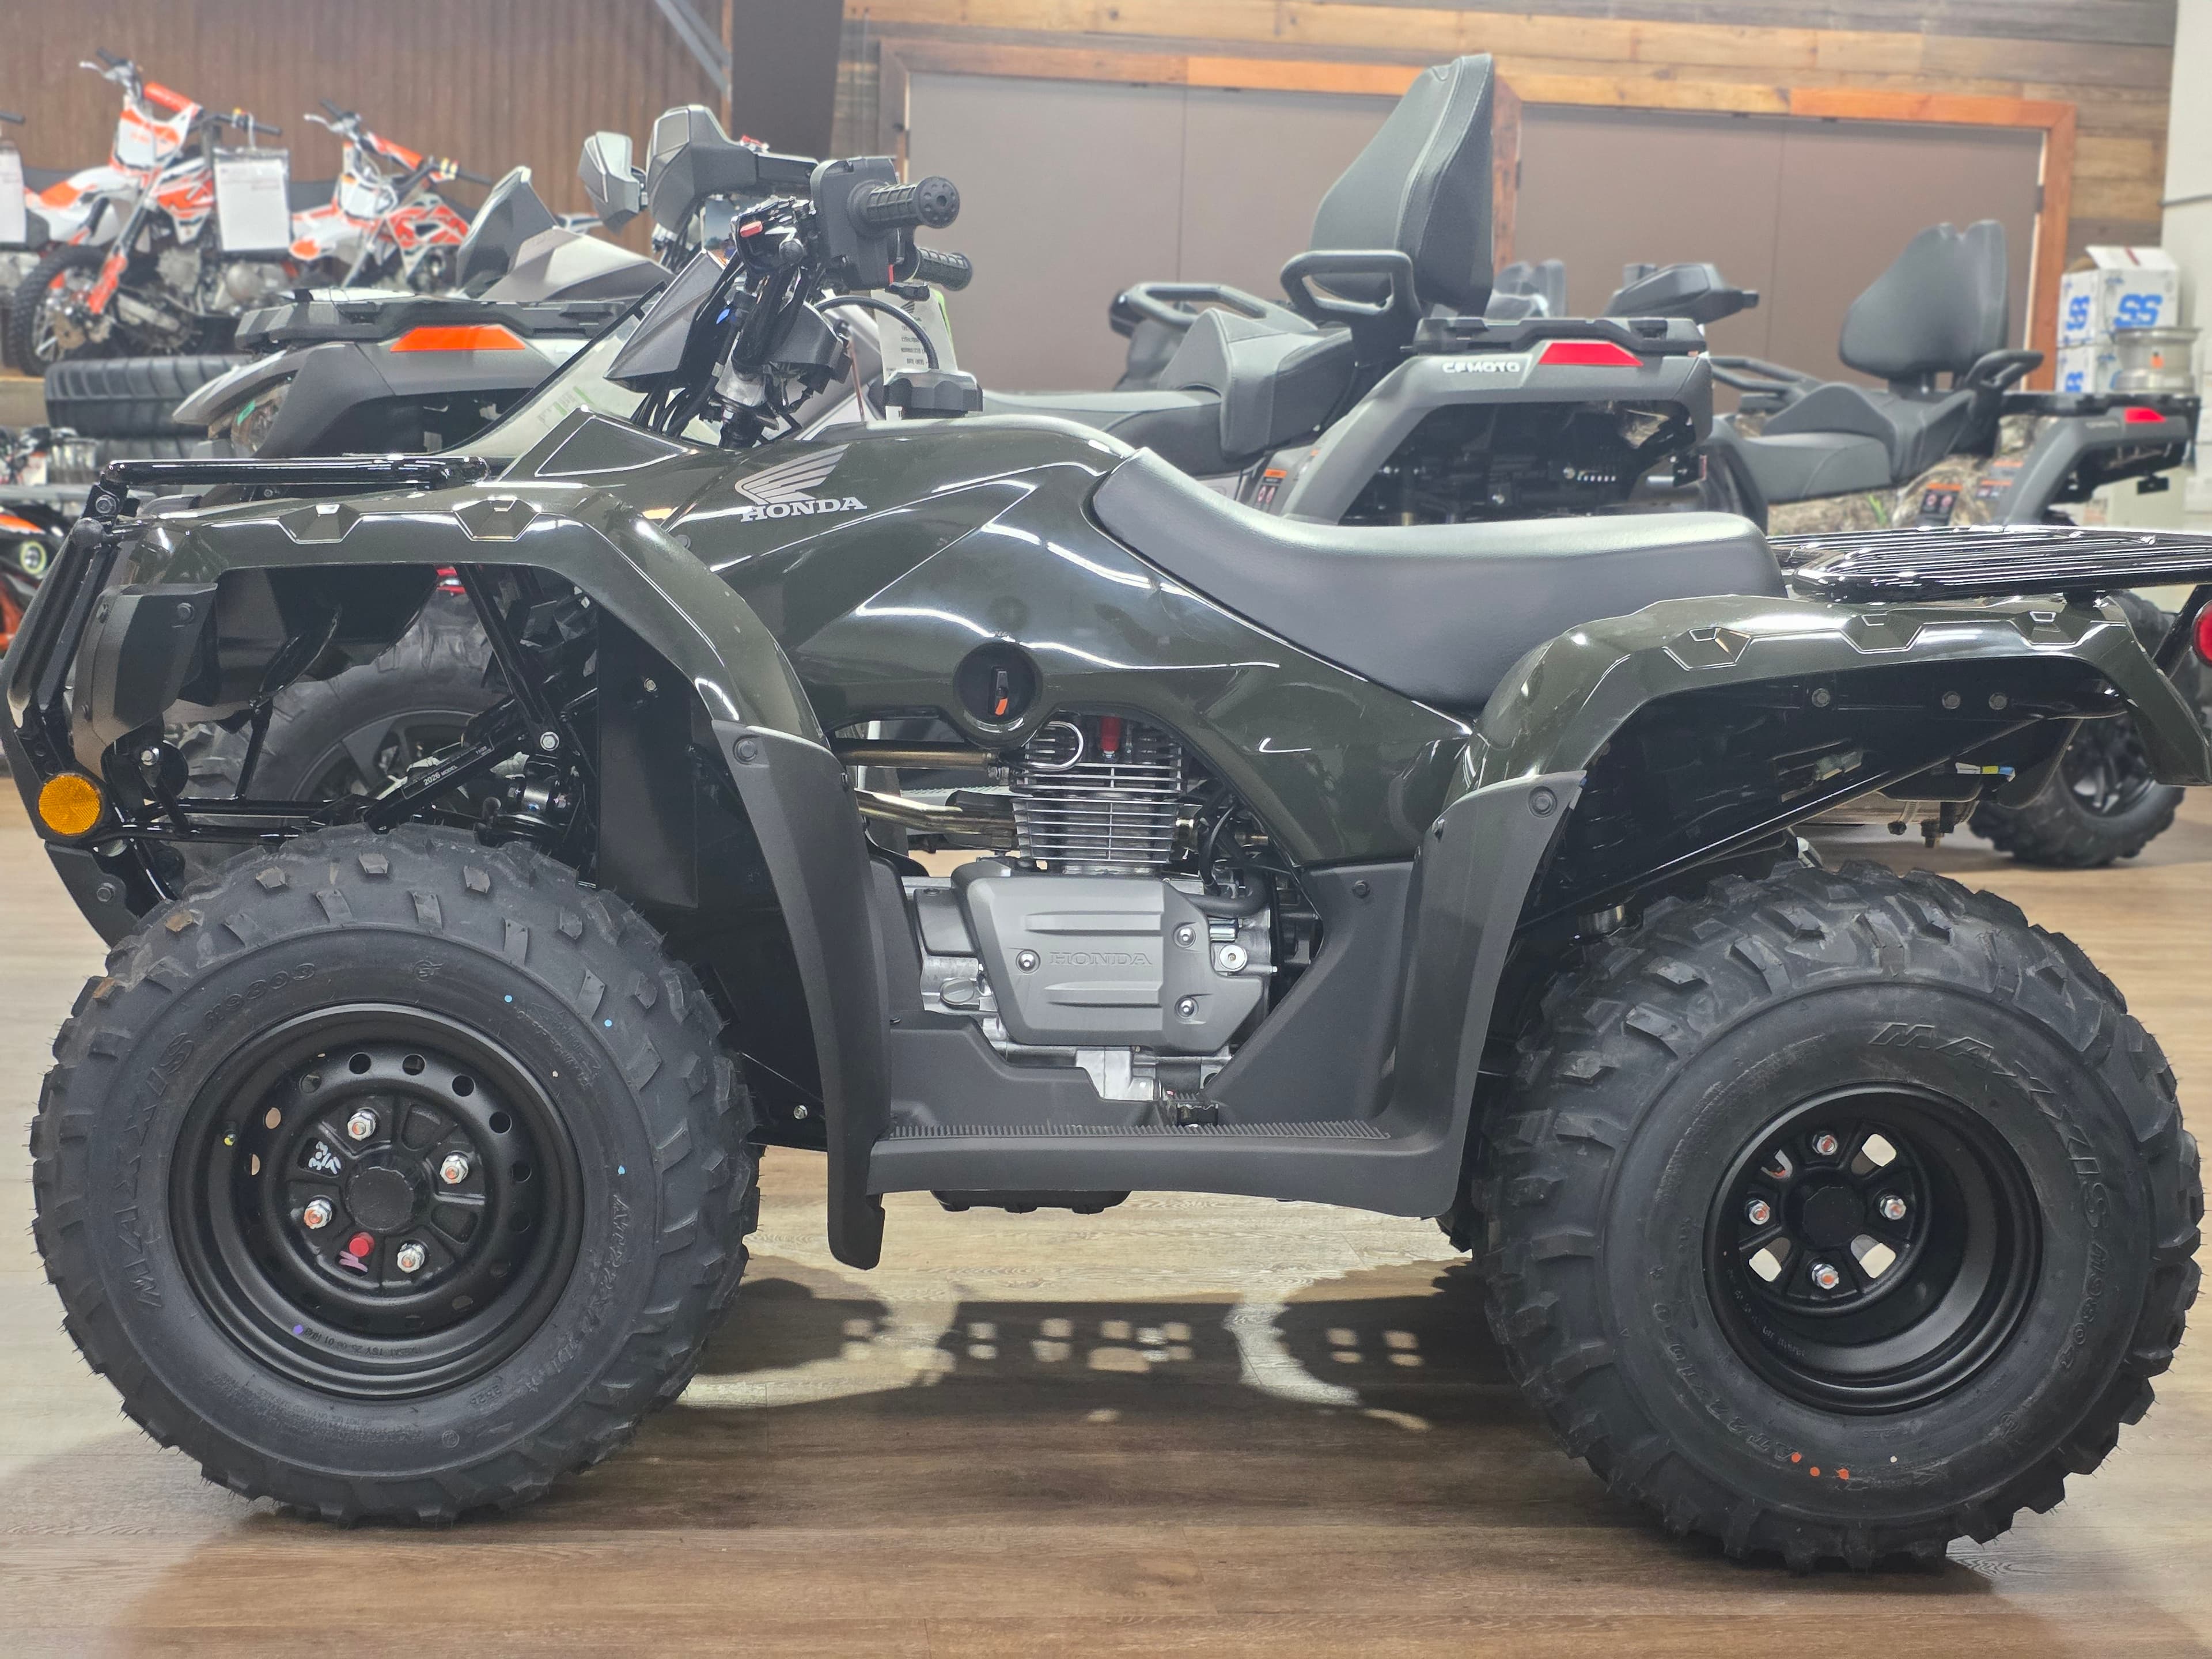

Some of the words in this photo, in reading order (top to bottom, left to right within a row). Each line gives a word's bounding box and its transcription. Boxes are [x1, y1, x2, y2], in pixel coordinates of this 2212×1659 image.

[1442, 361, 1521, 373] CFMOTO
[741, 497, 868, 522] HONDA
[423, 772, 441, 786] 2026
[1049, 952, 1153, 966] HONDA
[114, 1032, 195, 1308] MAXXIS
